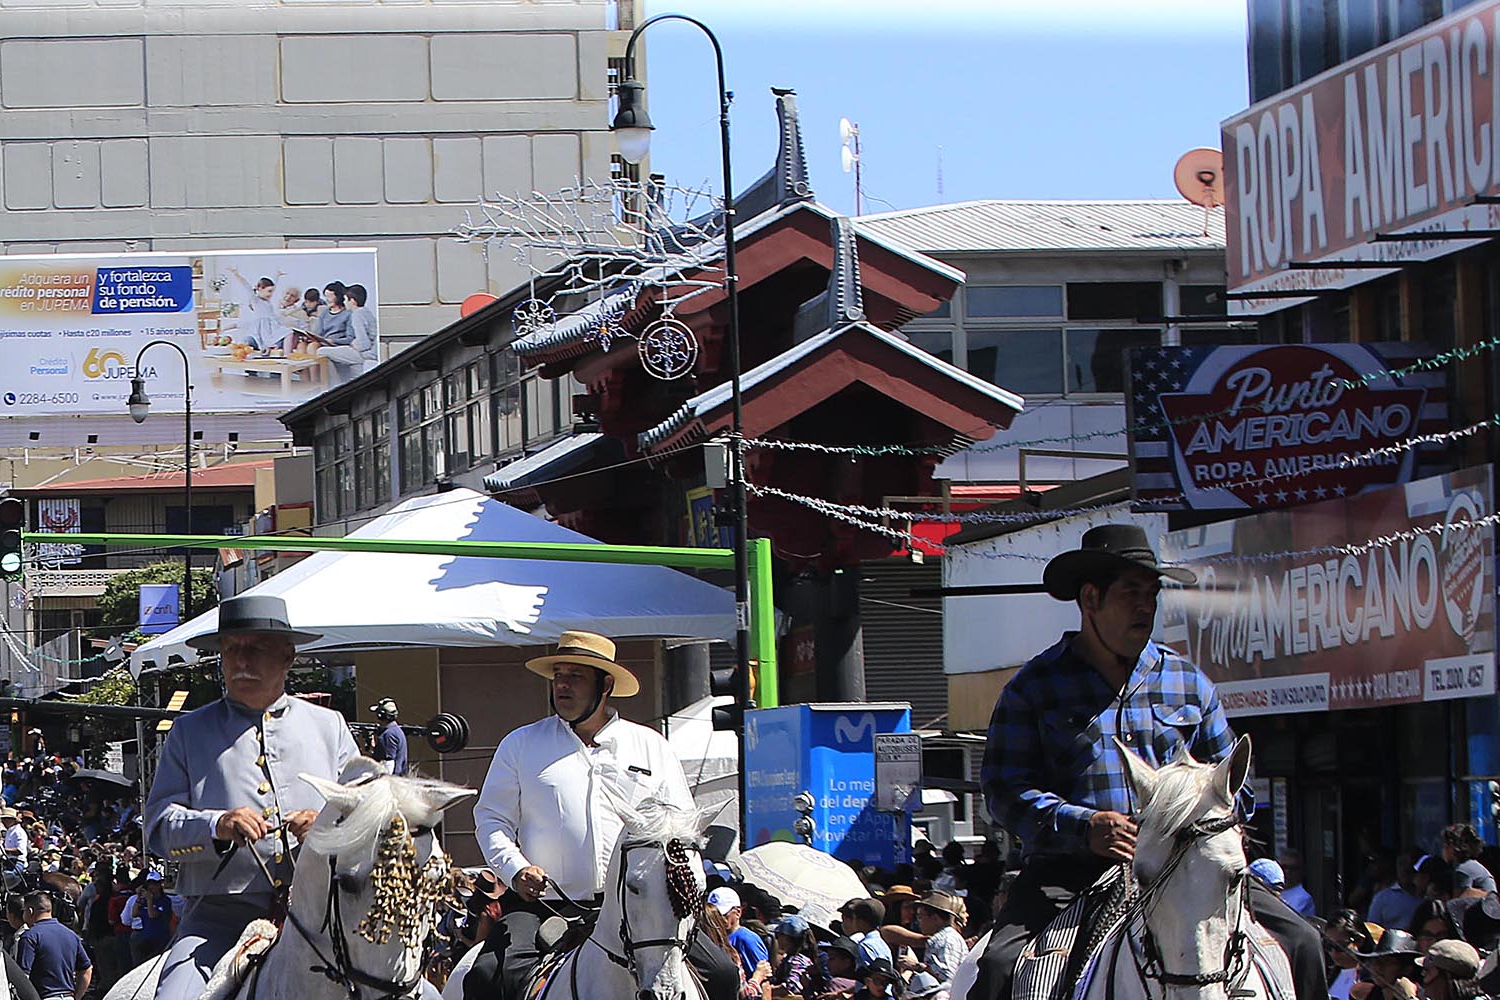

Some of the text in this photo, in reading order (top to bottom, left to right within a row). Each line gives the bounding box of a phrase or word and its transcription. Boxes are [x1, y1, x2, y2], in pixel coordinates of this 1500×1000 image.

[1236, 93, 1328, 278] ROPA
[19, 273, 89, 286] Adquiera un
[99, 270, 172, 284] y fortalezca
[37, 285, 90, 299] personal
[99, 283, 156, 296] su fondo
[20, 299, 90, 311] en JUPEMA
[100, 297, 116, 308] de
[63, 329, 84, 337] Hasta
[101, 329, 132, 337] millones
[146, 327, 194, 336] 15 años plazo
[30, 366, 69, 375] Personal
[104, 366, 158, 379] JUPEMA
[1227, 363, 1344, 416] Punto
[19, 392, 79, 405] 2284-6500
[1185, 404, 1412, 455] AMERICANO
[1195, 452, 1398, 482] ROPA AMERICANA
[1196, 534, 1438, 668] Punto AMERICANO
[830, 778, 846, 791] Lo
[820, 794, 839, 808] del
[829, 814, 846, 825] en
[849, 811, 861, 825] el
[813, 828, 872, 842] Movistar
